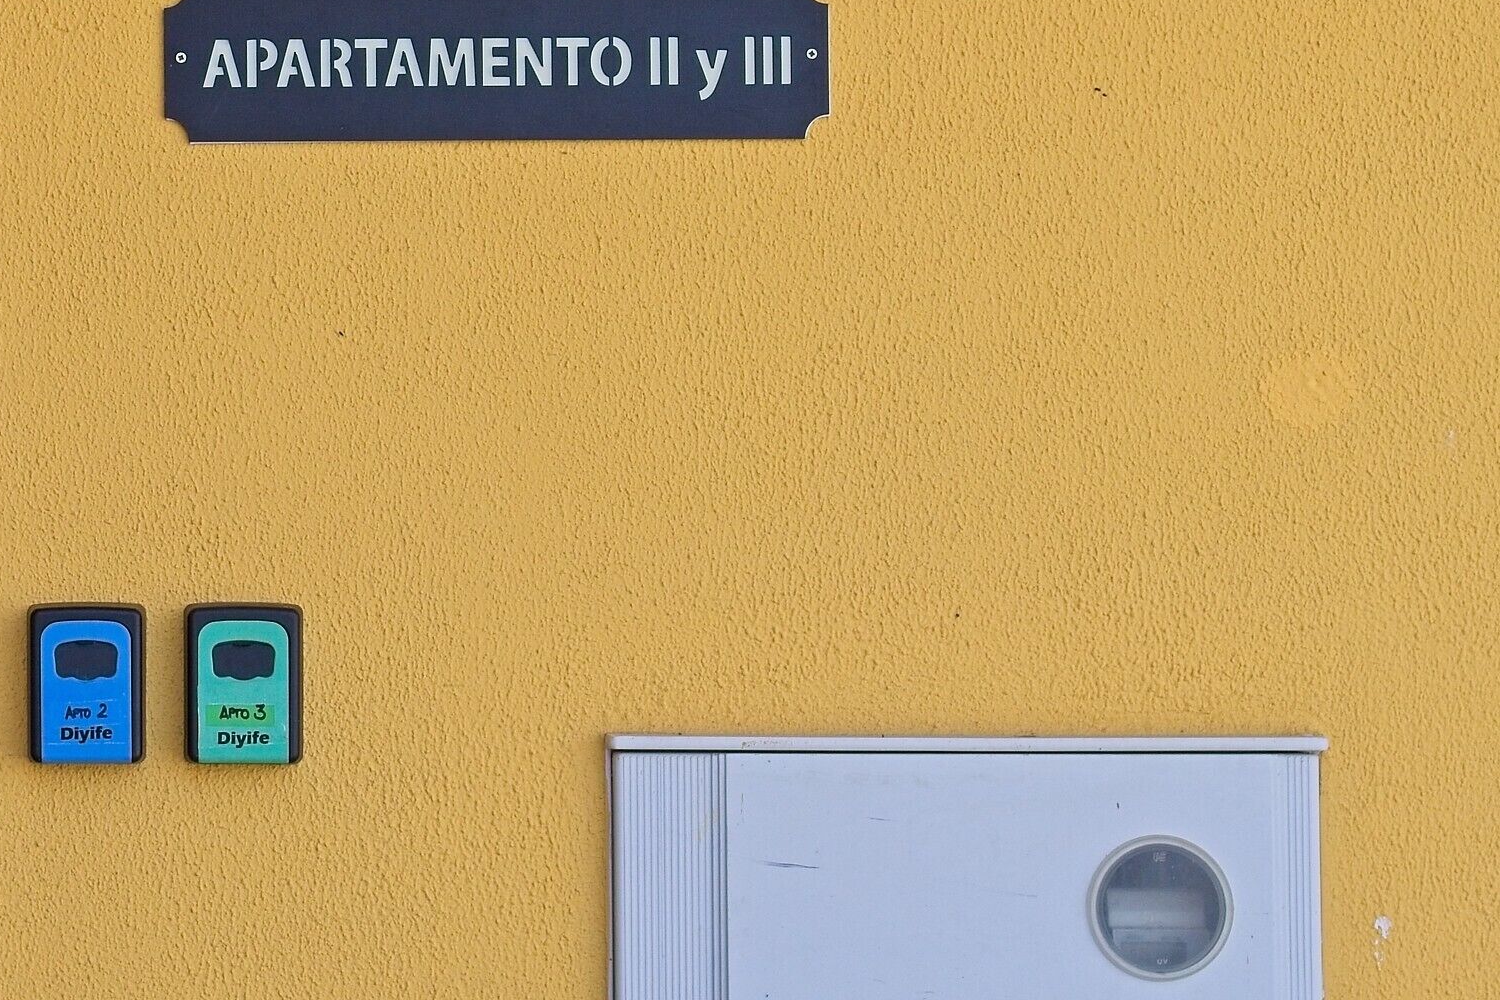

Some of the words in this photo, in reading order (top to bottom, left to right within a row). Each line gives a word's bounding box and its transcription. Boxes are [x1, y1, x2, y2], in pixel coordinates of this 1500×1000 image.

[202, 36, 632, 88] APARTAMENTO
[649, 36, 679, 86] II
[695, 49, 728, 101] y
[744, 36, 792, 85] III
[97, 702, 108, 719] 2
[253, 703, 267, 721] 3
[60, 725, 113, 744] Diyife
[217, 730, 270, 749] Diyife
